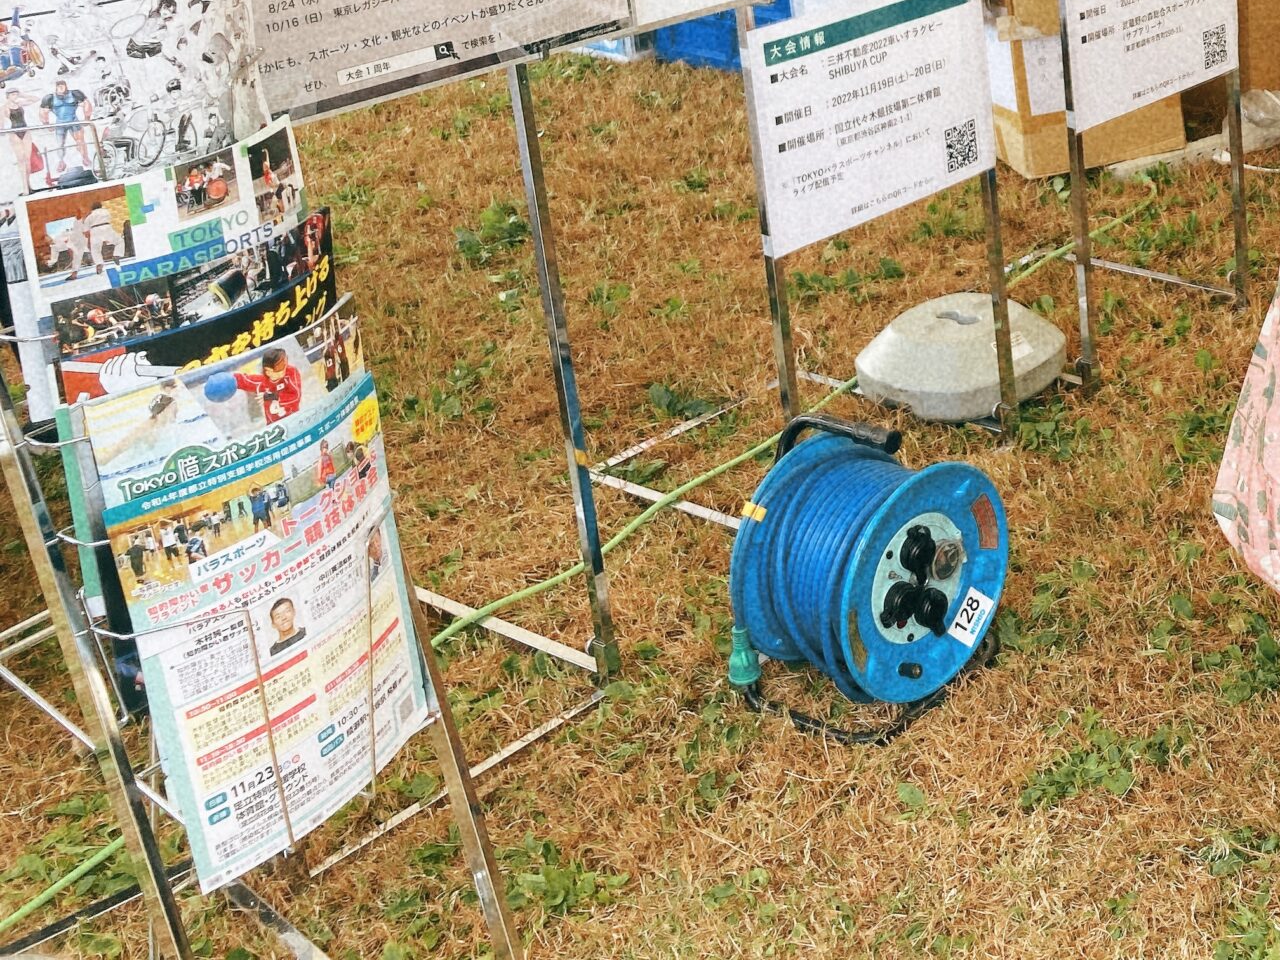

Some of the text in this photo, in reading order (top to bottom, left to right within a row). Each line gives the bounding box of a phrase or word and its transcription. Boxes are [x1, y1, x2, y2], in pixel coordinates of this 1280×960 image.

[770, 31, 826, 59] 大会情報
[780, 65, 809, 82] 大会名
[828, 52, 888, 80] SHIBUYA CUP
[784, 106, 813, 123] 開催日
[787, 130, 826, 150] 開催場所
[177, 209, 249, 249] TOKYO
[119, 221, 274, 287] PARASPORTS
[121, 471, 177, 501] TOKYO
[954, 596, 981, 633] 128
[969, 608, 986, 636] NISHIO
